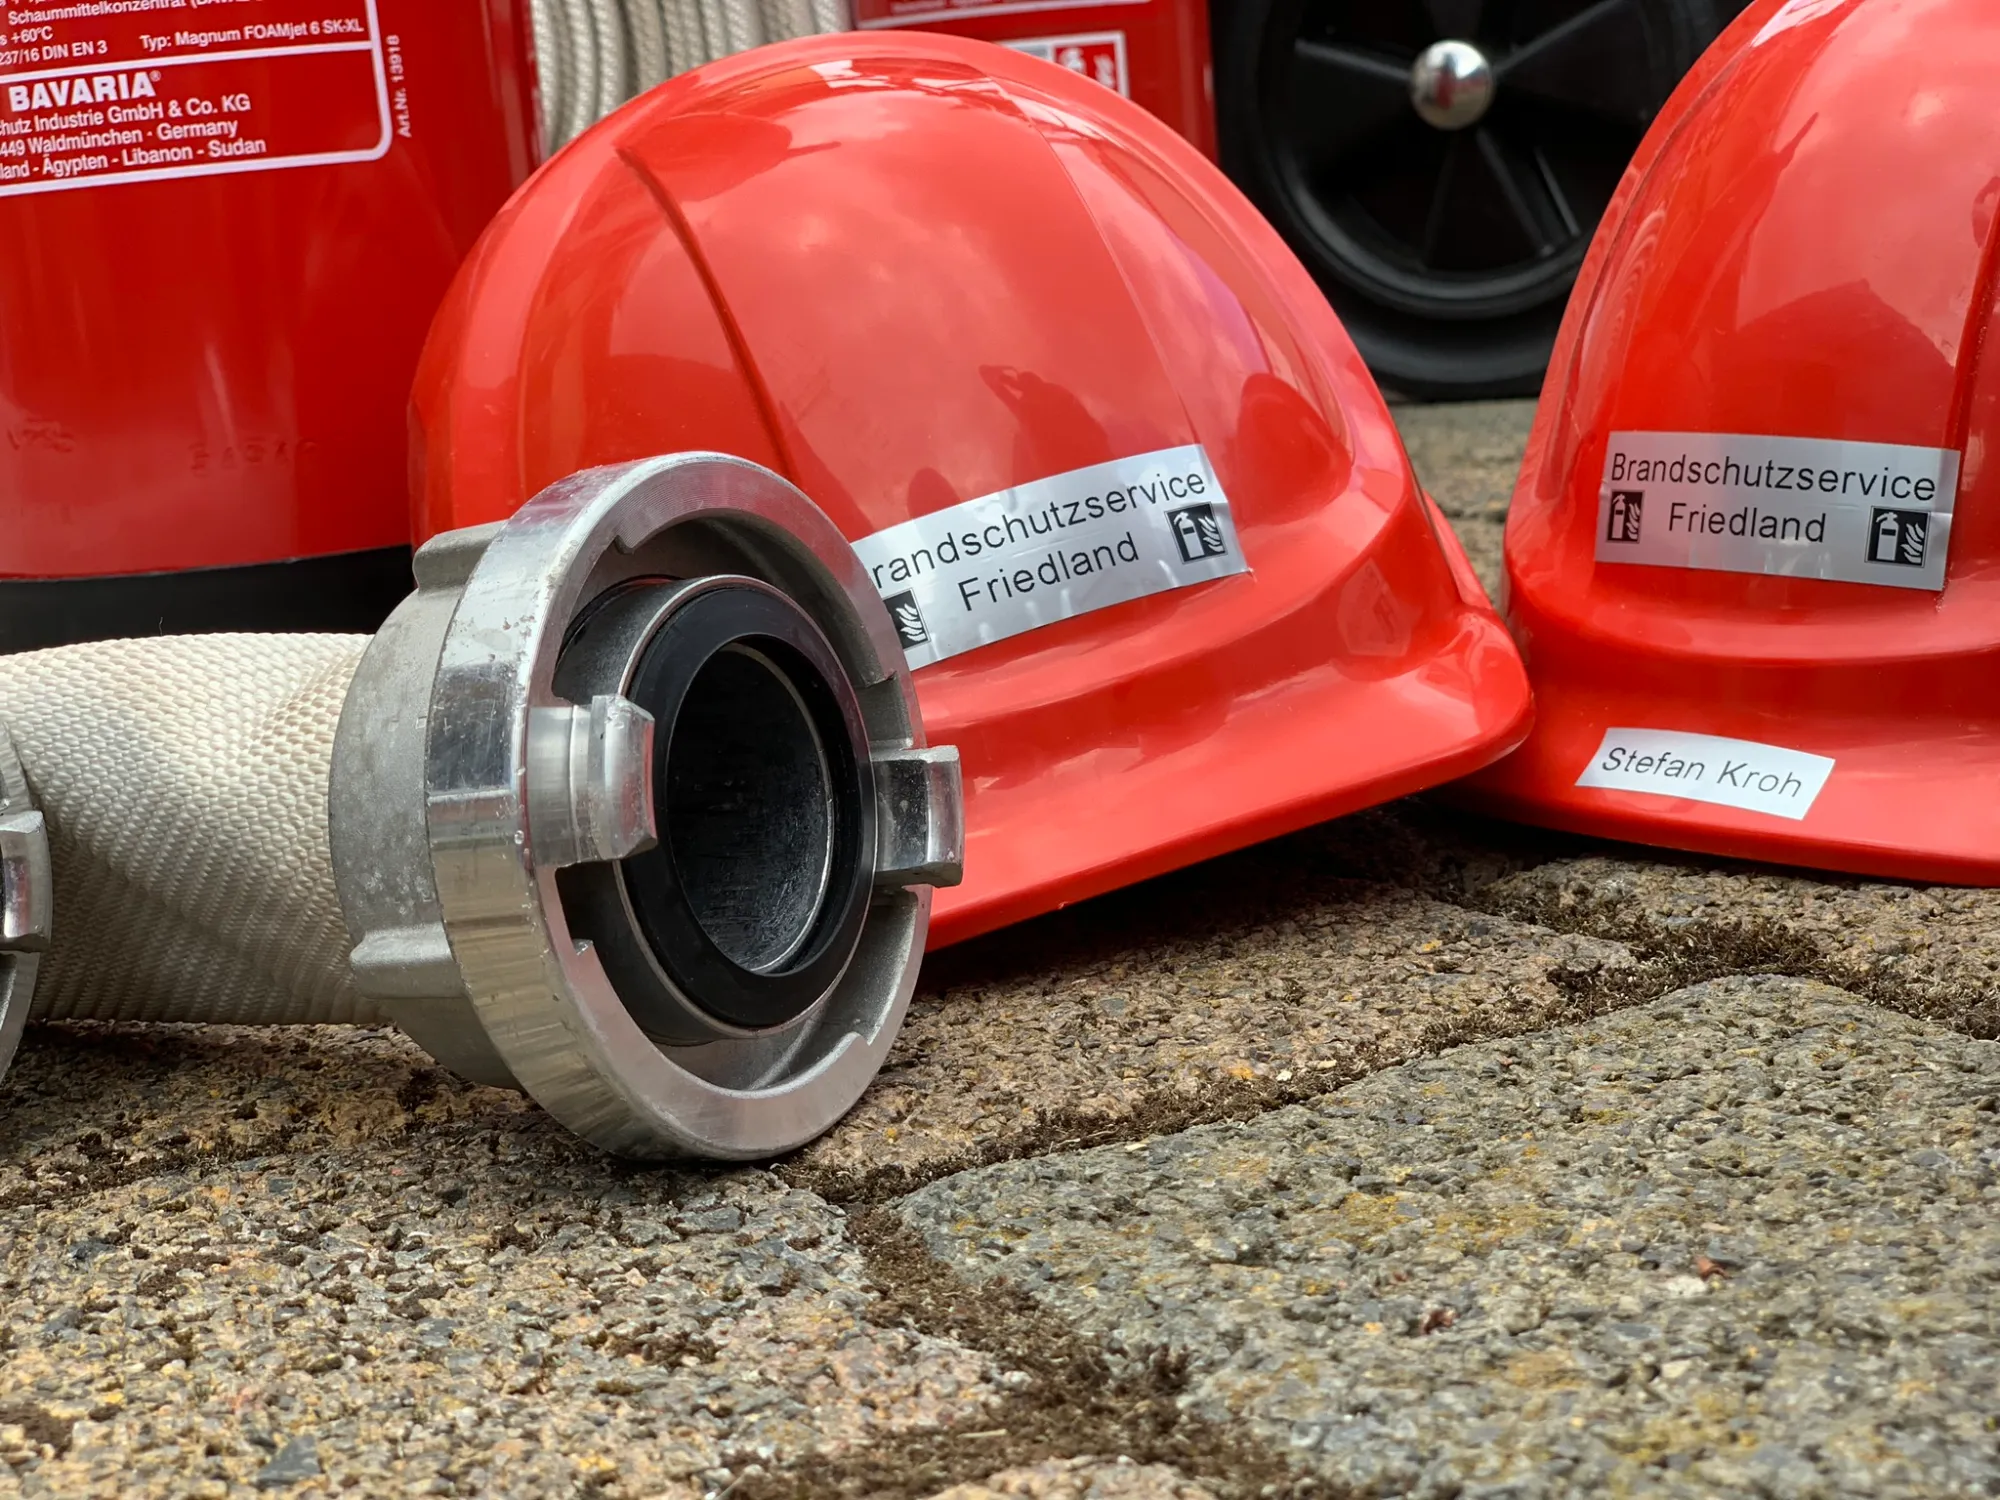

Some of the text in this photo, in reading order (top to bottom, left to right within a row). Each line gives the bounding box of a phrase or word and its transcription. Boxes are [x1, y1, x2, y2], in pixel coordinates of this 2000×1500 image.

[8, 0, 187, 25] Schaummittelkonzentrat
[11, 26, 54, 44] +60°C
[42, 43, 69, 60] DIN
[71, 41, 95, 57] EN
[97, 39, 108, 54] 3
[139, 34, 172, 52] Typ:
[174, 30, 241, 47] Magnum
[243, 22, 308, 40] FOAMjet
[309, 20, 320, 35] 6
[386, 34, 404, 83] 13918
[0, 92, 252, 137] hutz Industrie GmbH & Co. KG
[27, 128, 143, 155] Waldmünchen
[156, 119, 239, 141] Germany
[42, 153, 109, 178] Ägypten
[121, 145, 194, 167] Libanon
[207, 137, 267, 158] Sudan
[1611, 452, 1936, 501] Brandschutzservice
[872, 472, 1206, 589] randschutzservice
[1668, 502, 1827, 543] Friedland
[957, 531, 1139, 612] Friedland
[1602, 747, 1802, 798] Stefan Kroh
